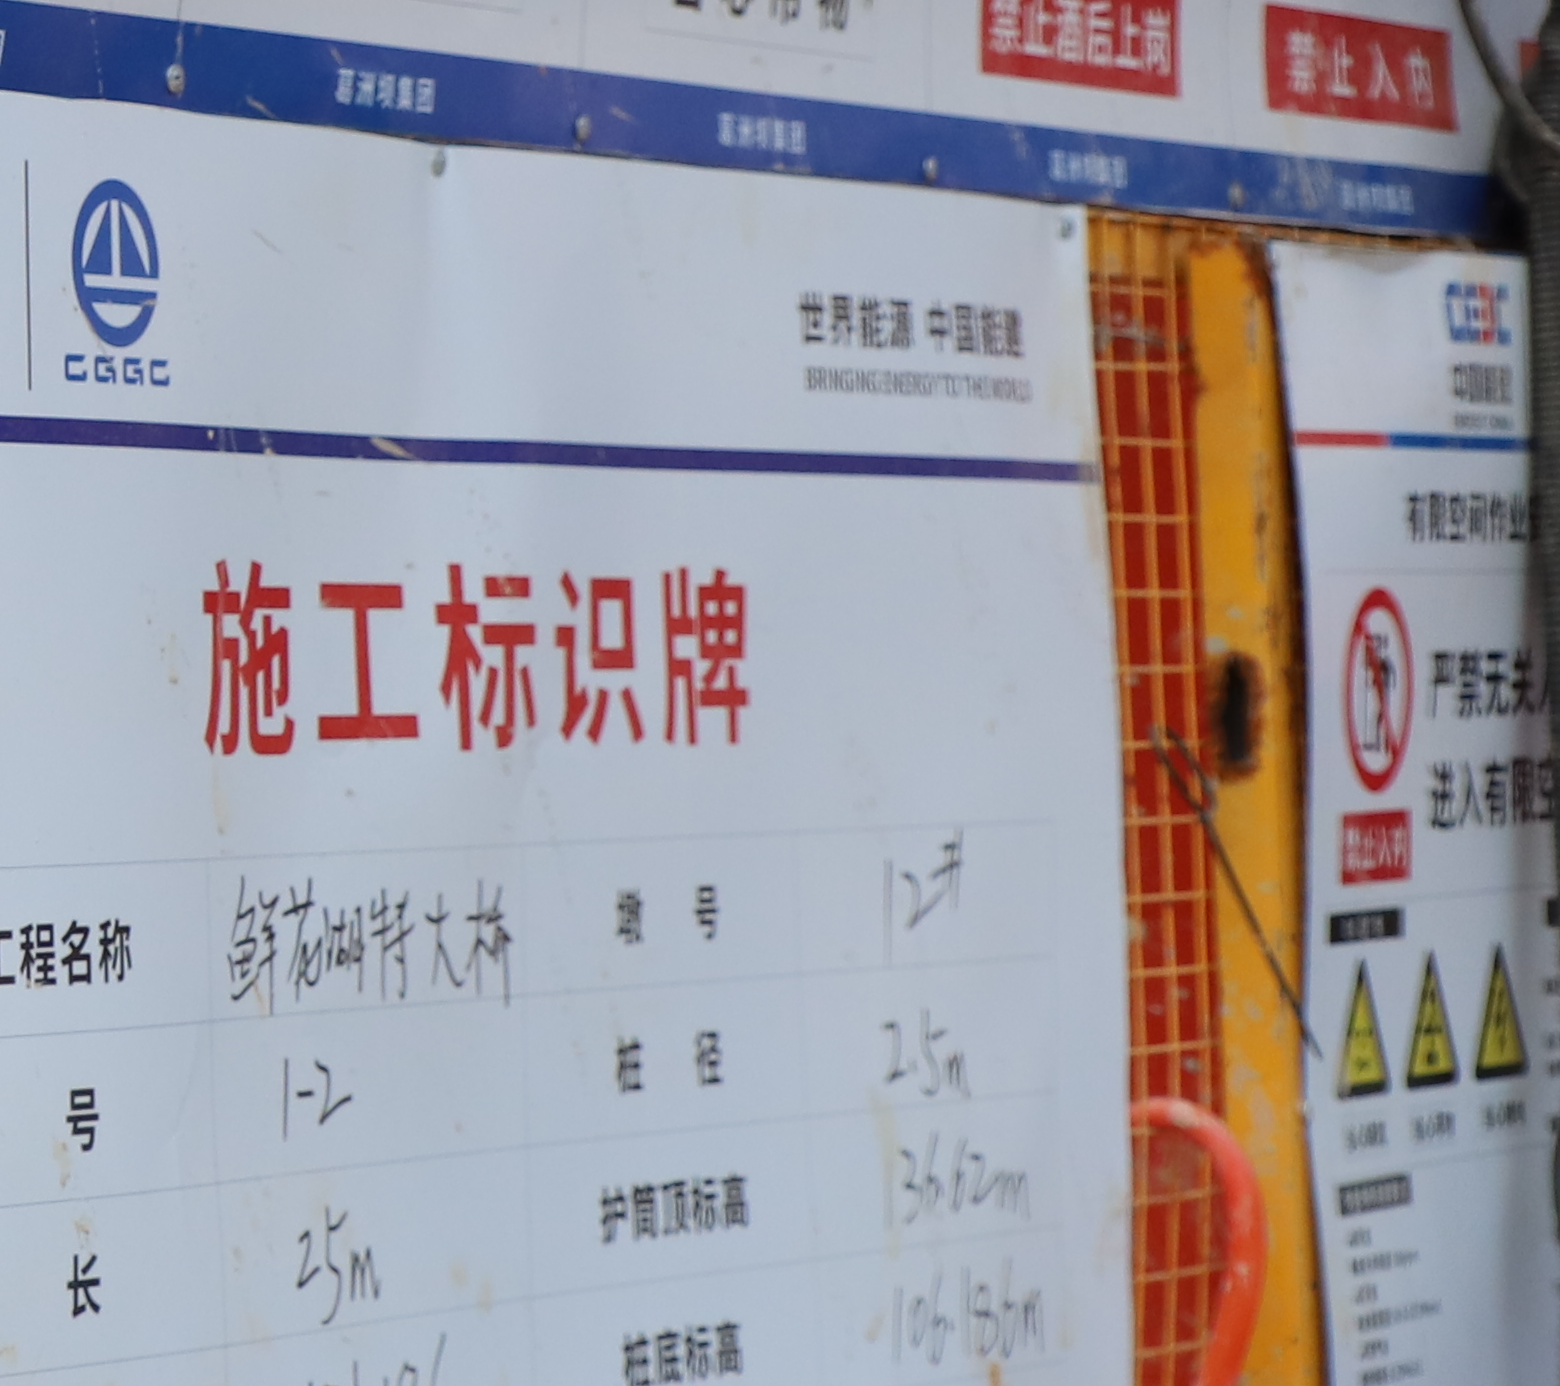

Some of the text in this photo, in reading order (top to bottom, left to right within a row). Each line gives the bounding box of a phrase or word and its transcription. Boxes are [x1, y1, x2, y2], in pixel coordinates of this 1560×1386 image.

[334, 67, 436, 115] 葛洲坝集团
[1285, 29, 1435, 109] 禁止入内
[799, 292, 1026, 357] 世界能源 中国能建
[65, 354, 170, 387] CGGC
[204, 559, 751, 757] 施工标识牌
[281, 1058, 352, 1142] 1-2
[598, 1174, 750, 1245] 护筒顶标高
[296, 1205, 381, 1325] 25m
